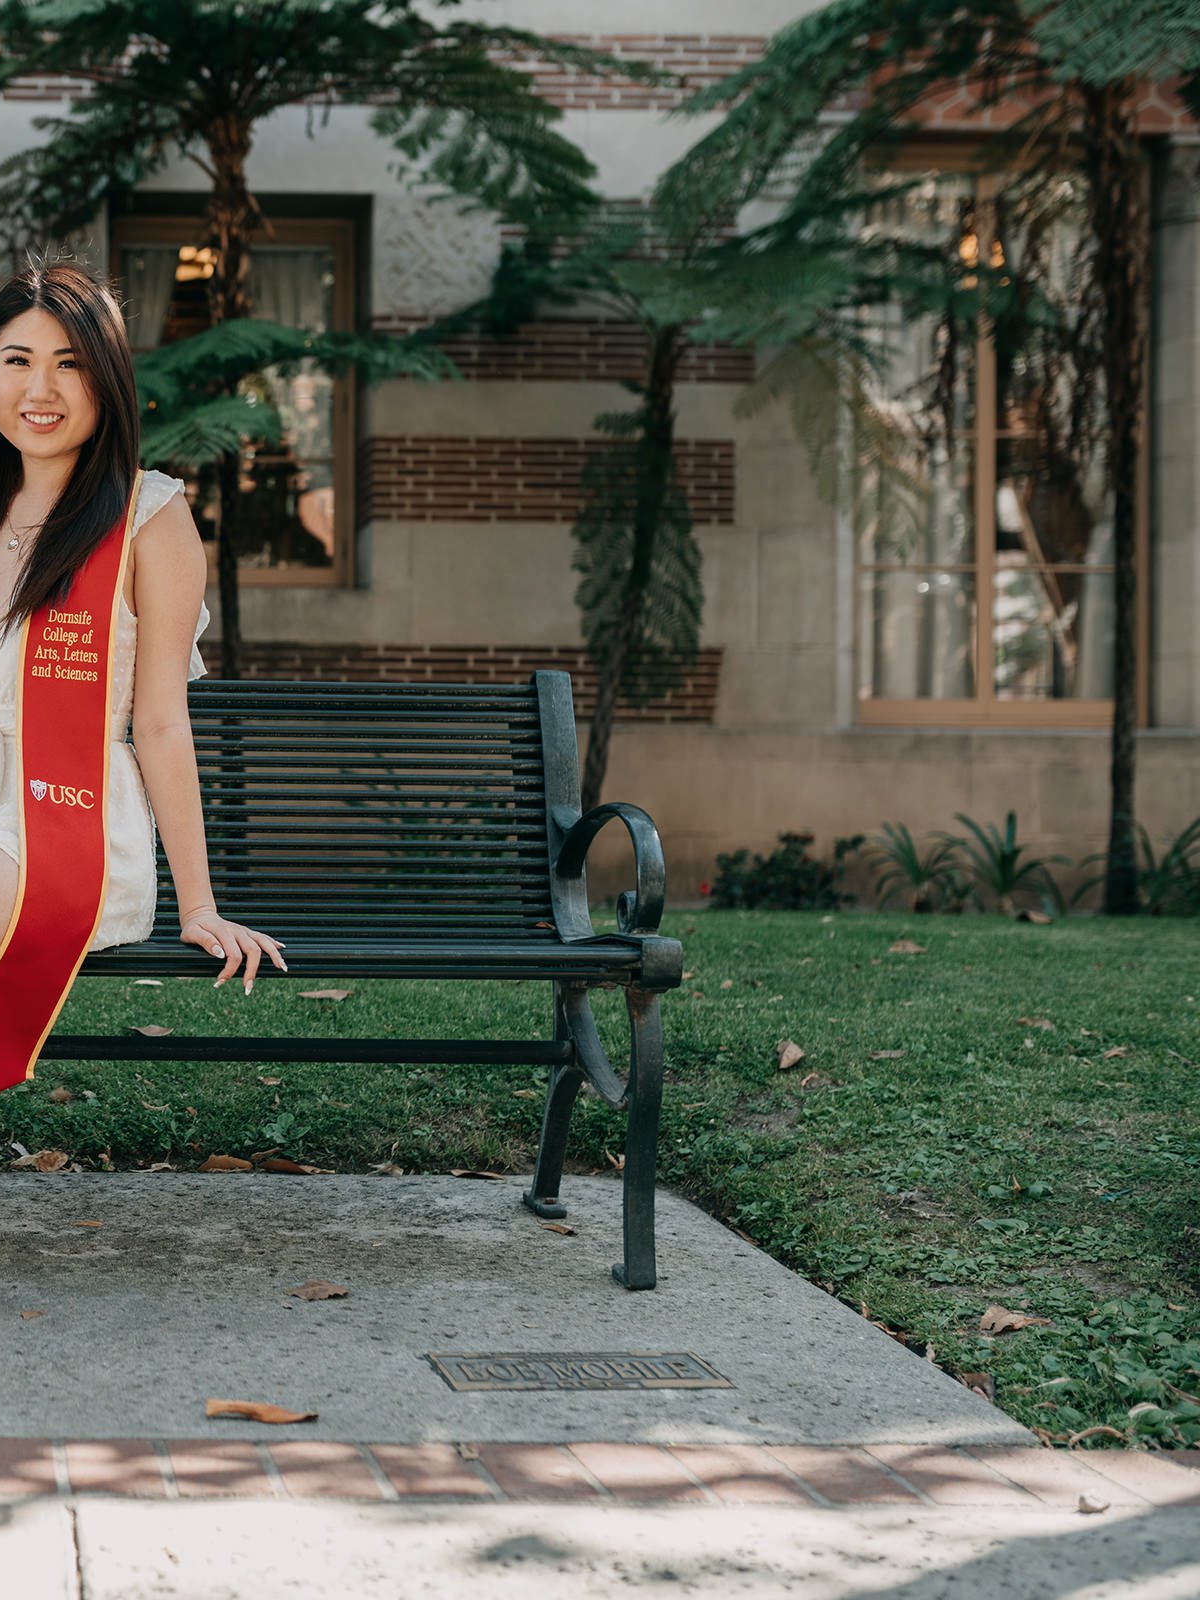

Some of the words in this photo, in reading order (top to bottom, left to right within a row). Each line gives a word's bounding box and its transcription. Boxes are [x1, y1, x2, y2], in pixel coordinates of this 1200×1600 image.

[48, 609, 92, 625] Dornsife
[43, 627, 79, 646] College
[81, 629, 94, 645] of
[34, 645, 60, 662] Arts,
[63, 647, 98, 664] Letters
[31, 664, 51, 679] and
[54, 665, 98, 682] Sciences
[47, 784, 95, 810] USC
